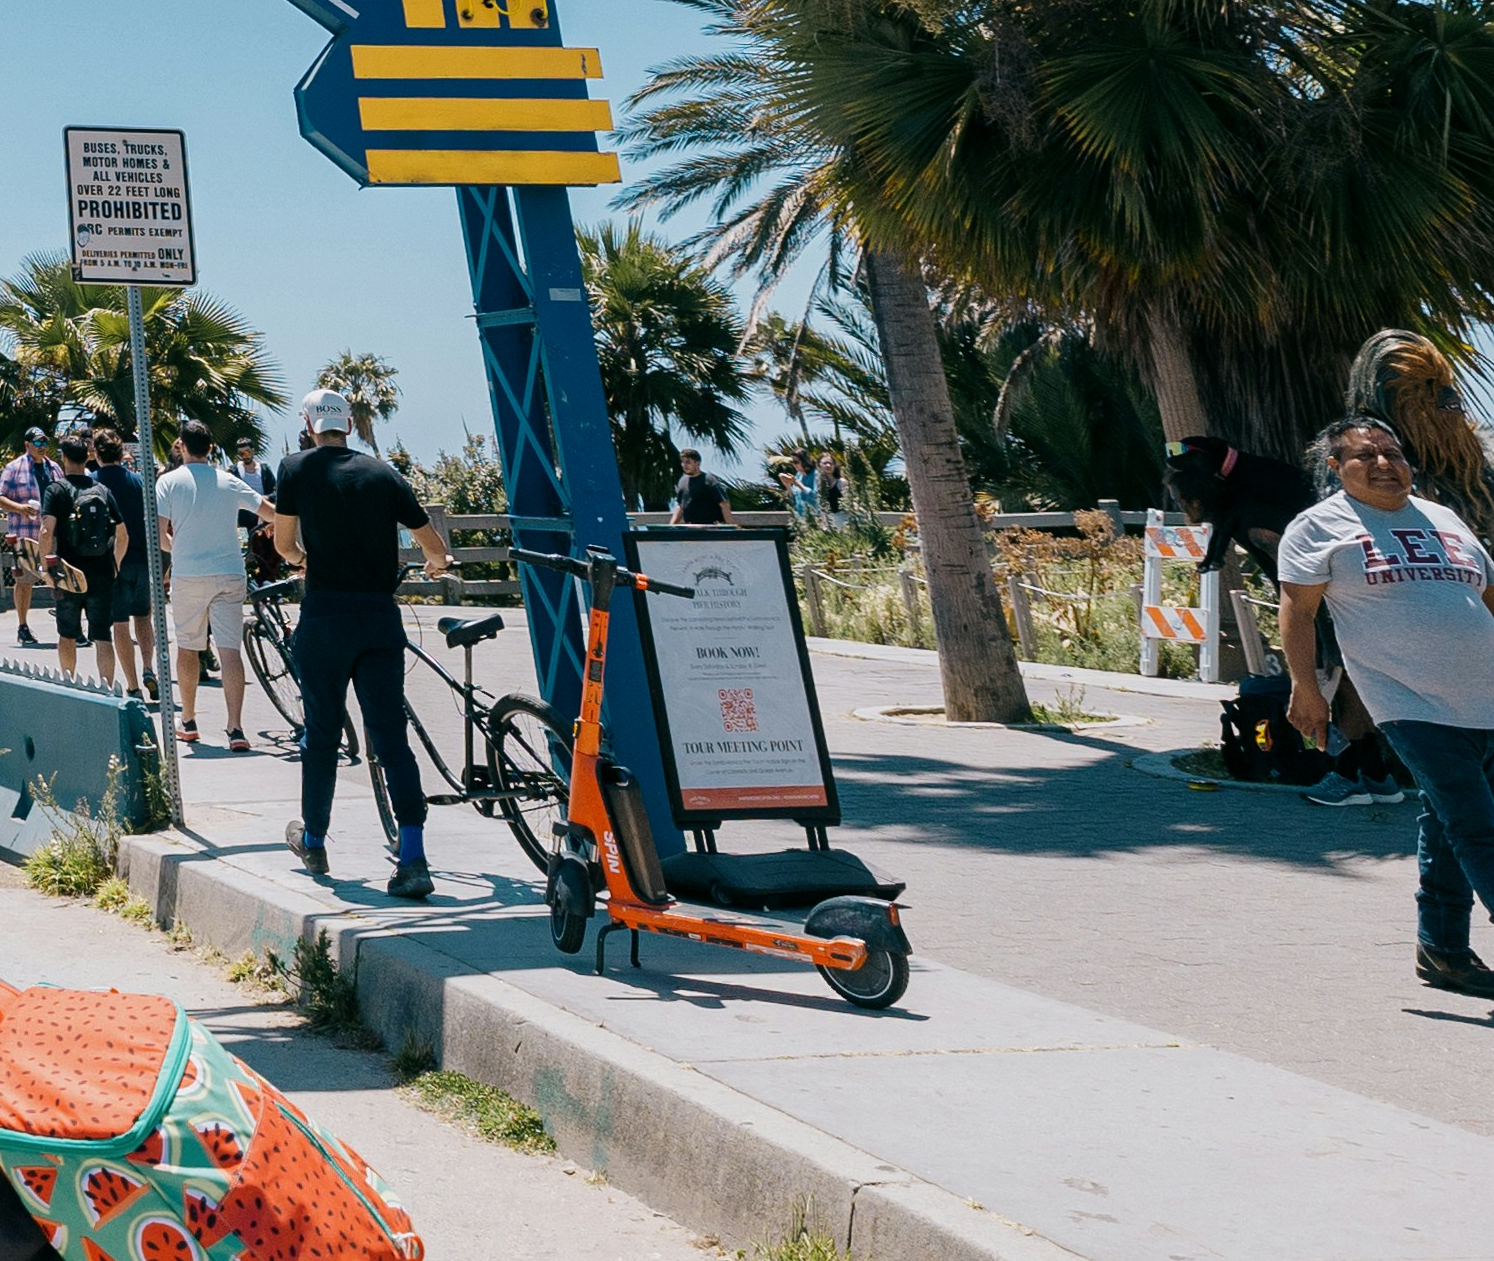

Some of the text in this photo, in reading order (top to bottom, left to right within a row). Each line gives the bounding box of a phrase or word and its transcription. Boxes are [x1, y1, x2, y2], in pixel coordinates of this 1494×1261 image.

[84, 142, 168, 157] BUSES, TRUCKS,
[83, 157, 170, 170] MOTOR HOMES &
[93, 171, 162, 183] ALL VEHICLES
[77, 185, 181, 198] OVER 22 FEET LONG
[78, 200, 182, 220] PROHIBITED
[108, 227, 145, 236] PERMITS
[149, 227, 183, 238] EXEMPT
[82, 248, 184, 260] DELIVERIES PERMITTED ONLY
[100, 259, 105, 267] 5
[316, 405, 342, 413] BOSS
[1355, 528, 1479, 570] LEE
[1365, 567, 1483, 587] UNIVERSITY
[696, 646, 760, 659] BOOK NOW!
[683, 739, 803, 755] TOUR MEETING POINT
[603, 830, 620, 874] SPIN
